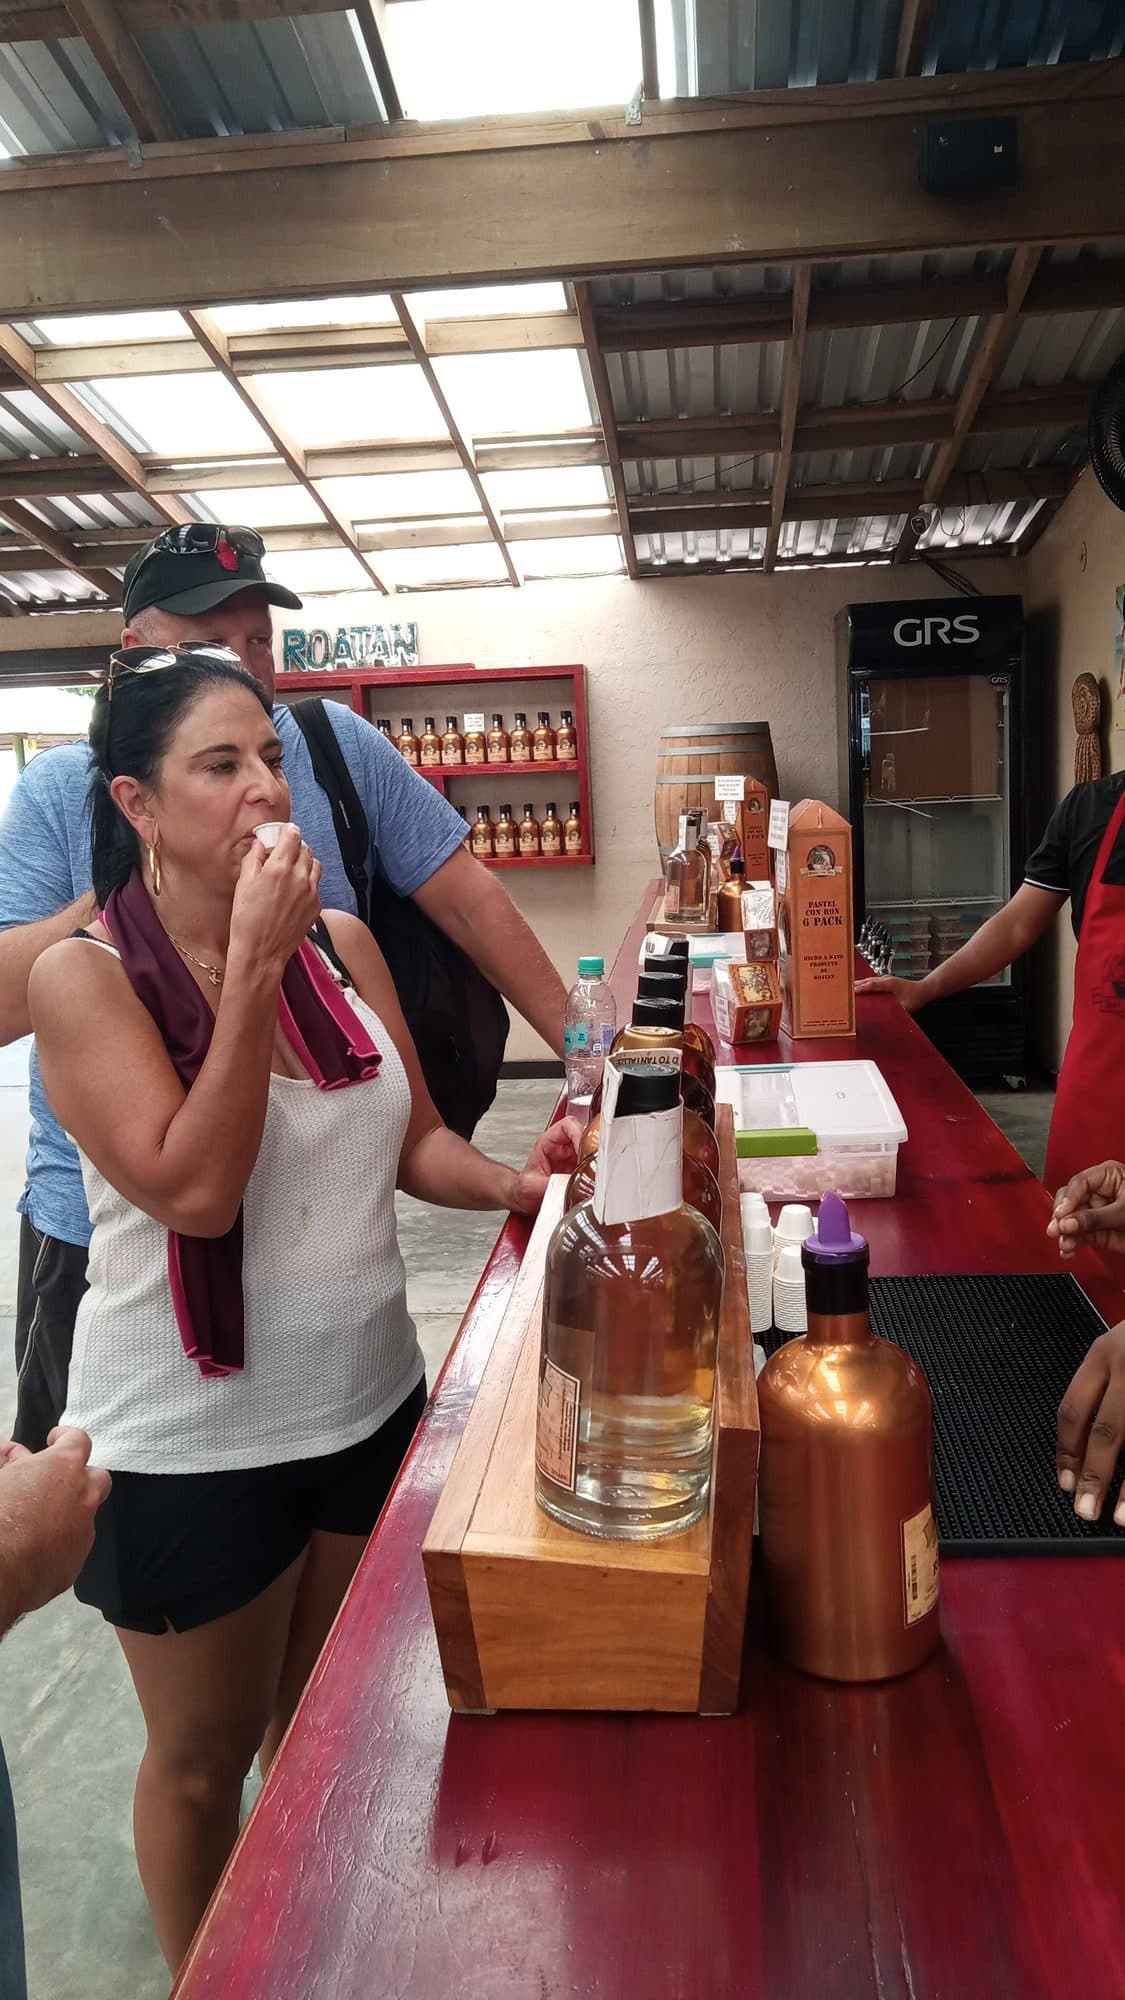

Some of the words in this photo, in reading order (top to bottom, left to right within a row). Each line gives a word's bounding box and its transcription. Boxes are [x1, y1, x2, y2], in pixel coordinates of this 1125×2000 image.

[893, 614, 980, 647] GRS
[282, 622, 419, 673] ROATAN
[991, 676, 1009, 684] GRS
[808, 900, 838, 909] PASTEL
[805, 908, 821, 917] CON
[823, 908, 840, 916] RON
[802, 917, 810, 927] 6
[813, 916, 843, 927] PACK
